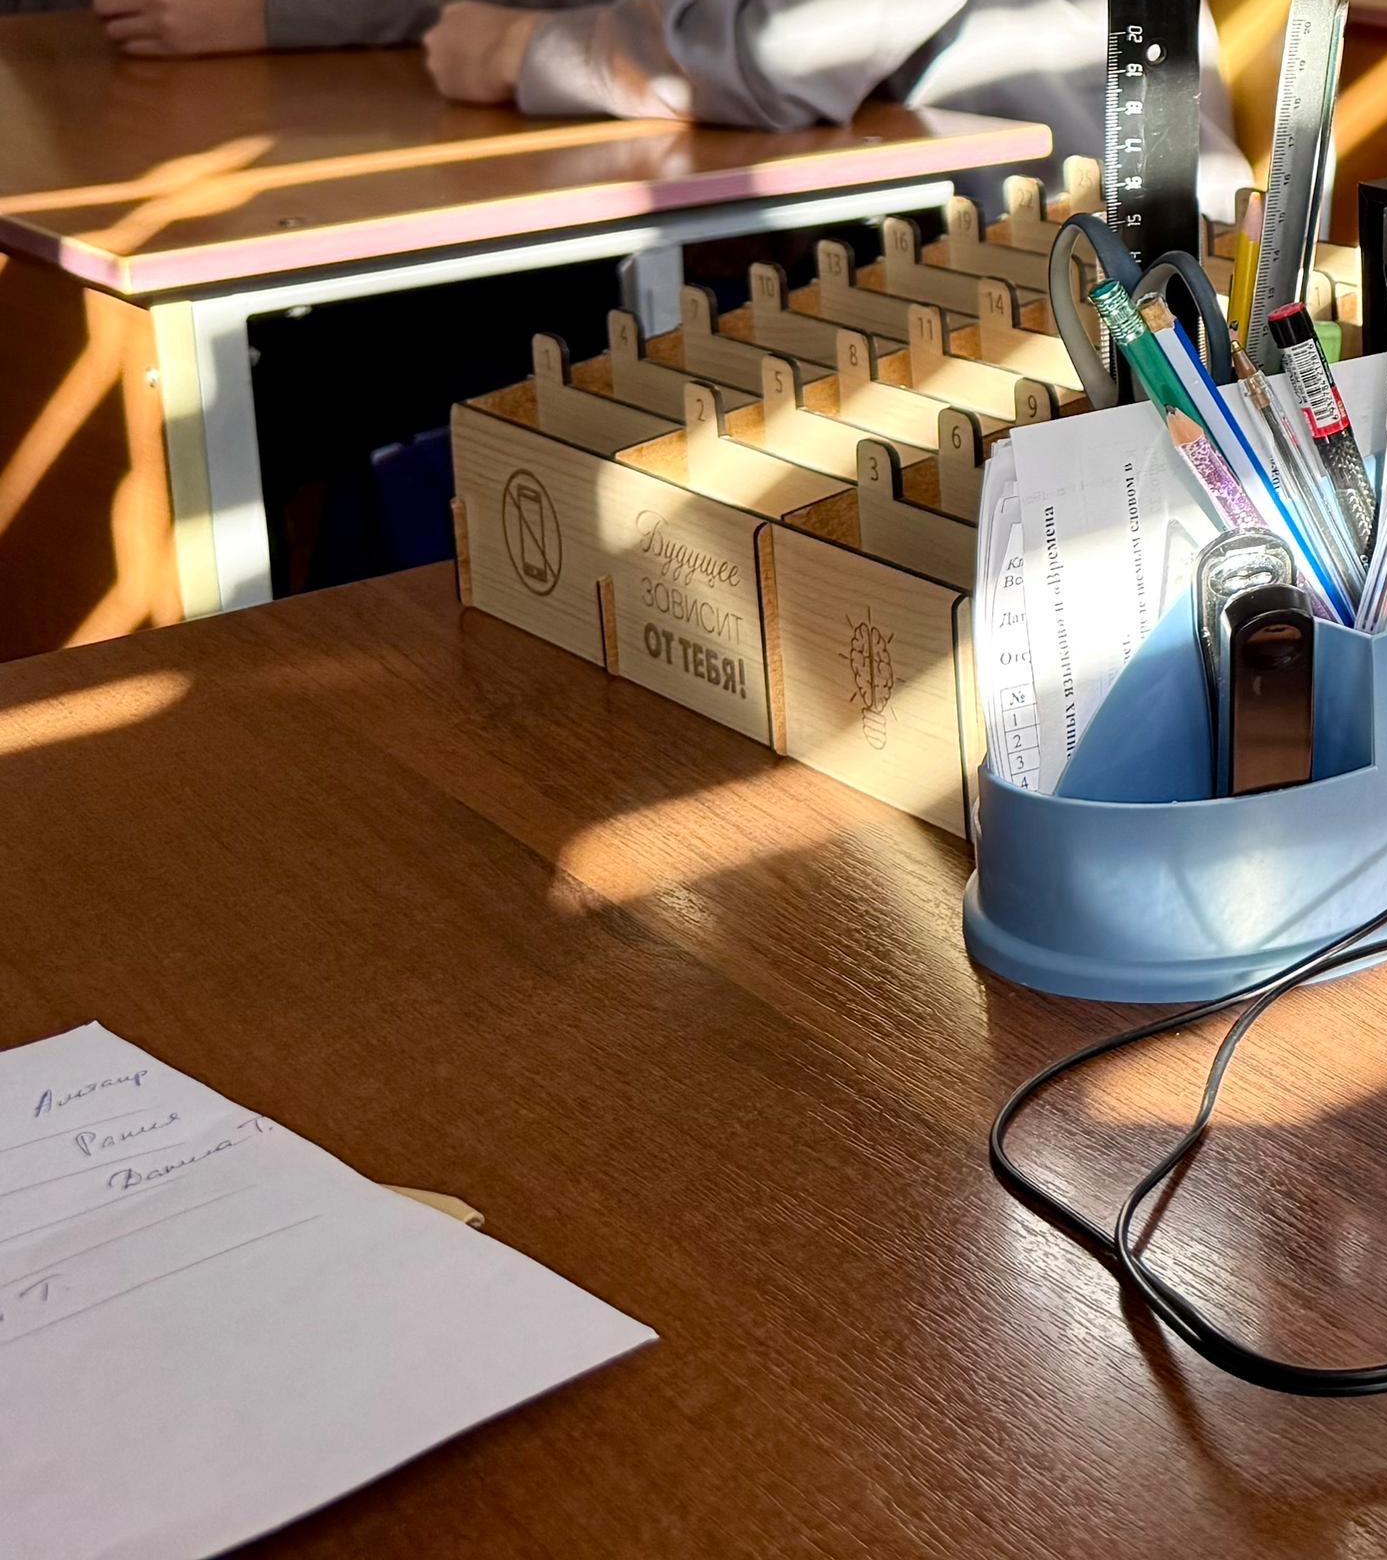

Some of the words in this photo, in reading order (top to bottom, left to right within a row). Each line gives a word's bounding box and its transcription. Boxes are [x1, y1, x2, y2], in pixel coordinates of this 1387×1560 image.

[1129, 26, 1143, 43] 20
[1128, 64, 1143, 77] 19
[1126, 100, 1143, 115] 18
[1125, 138, 1143, 152] 17
[1126, 176, 1142, 190] 16
[958, 210, 972, 231] 19
[1127, 214, 1141, 227] 15
[894, 231, 908, 250] 16
[825, 251, 841, 274] 13
[759, 274, 775, 297] 10
[986, 291, 1004, 314] 14
[919, 317, 934, 340] 11
[849, 345, 858, 366] 8
[774, 372, 784, 393] 5
[697, 399, 705, 421] 2
[1028, 395, 1037, 417] 9
[952, 425, 961, 449] 6
[868, 457, 880, 481] 3
[636, 510, 741, 588] Будущее
[644, 622, 674, 665] ОТ
[679, 637, 746, 699] ТЕБЯ!
[1012, 715, 1018, 727] 1
[1014, 735, 1022, 748] 2
[1018, 756, 1024, 770] 3
